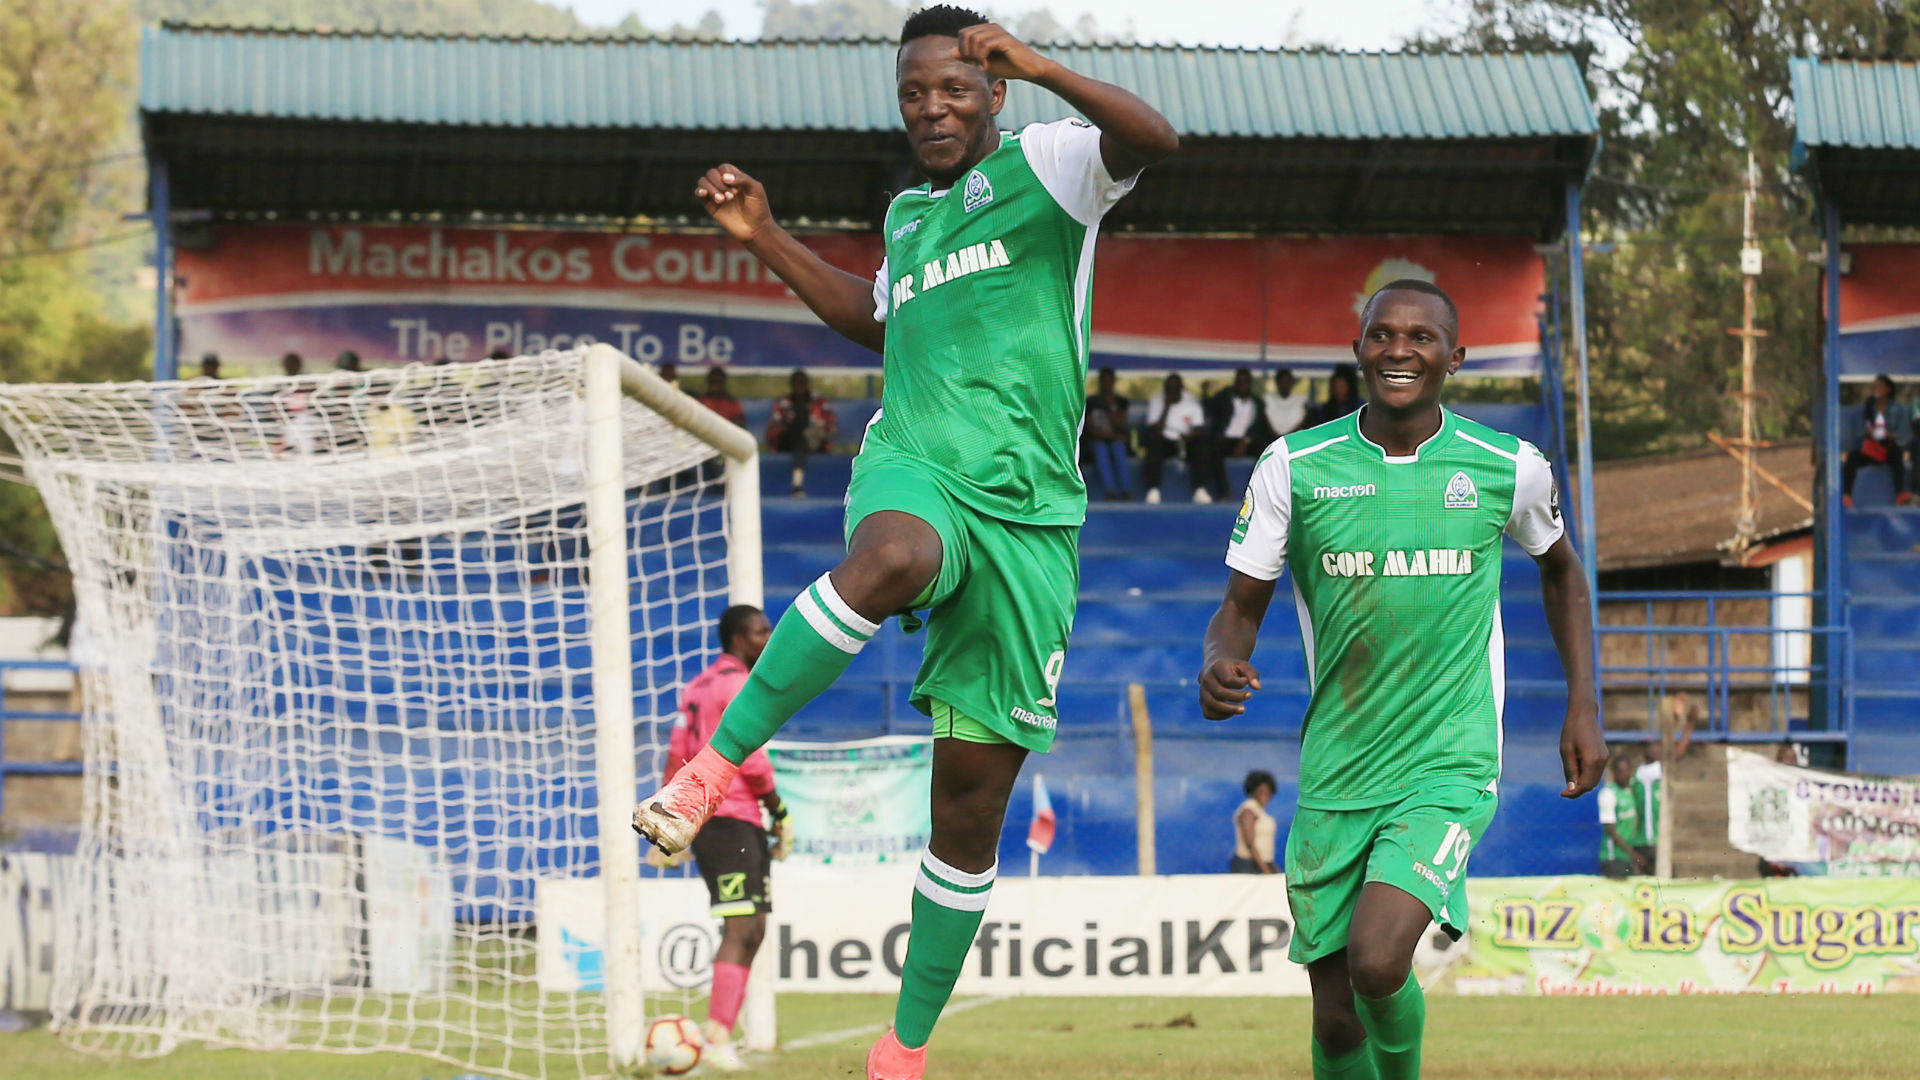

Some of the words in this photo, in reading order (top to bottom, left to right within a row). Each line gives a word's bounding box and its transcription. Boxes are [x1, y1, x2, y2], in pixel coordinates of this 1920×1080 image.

[307, 229, 593, 284] Machakos
[611, 235, 800, 297] Coun
[892, 273, 916, 318] OR
[921, 239, 1011, 291] MAHIA
[389, 317, 469, 360] The
[610, 323, 663, 362] To
[678, 324, 734, 363] Be
[1313, 483, 1376, 499] macron
[1321, 550, 1376, 578] GOR
[1382, 548, 1472, 577] MAHIA
[1036, 650, 1065, 707] 9
[1010, 706, 1057, 729] macron
[1432, 821, 1472, 881] 19
[1726, 891, 1919, 962] Sugar
